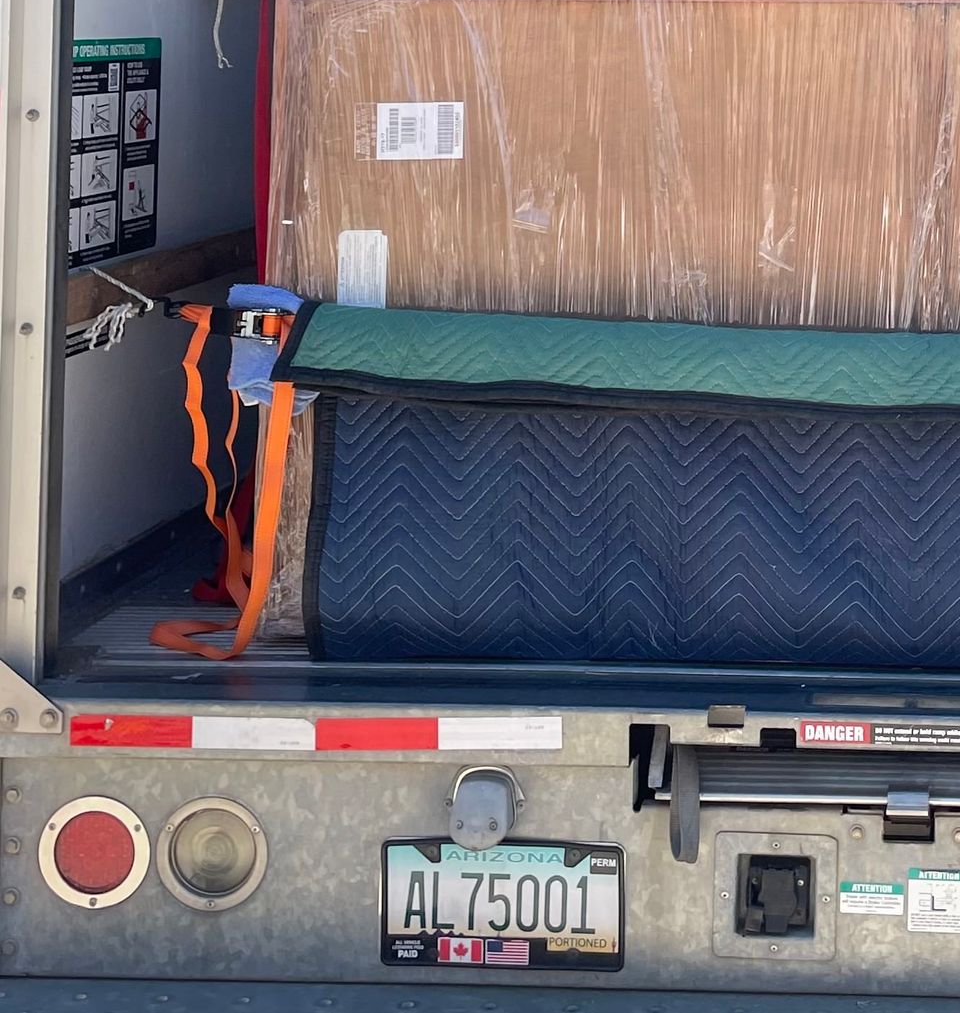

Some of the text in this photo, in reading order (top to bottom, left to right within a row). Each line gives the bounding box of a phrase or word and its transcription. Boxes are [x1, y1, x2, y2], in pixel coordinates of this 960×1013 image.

[80, 45, 109, 57] OPERATING
[110, 44, 145, 56] INSTRUCTIONS
[804, 724, 864, 742] DANGER
[446, 850, 563, 864] ARIZONA
[590, 858, 617, 868] PERM
[919, 871, 960, 880] ATTENTION
[852, 883, 893, 893] ATTENTION
[404, 870, 596, 935] AL75001
[550, 937, 607, 948] PORTIONED
[398, 950, 418, 958] PAID
